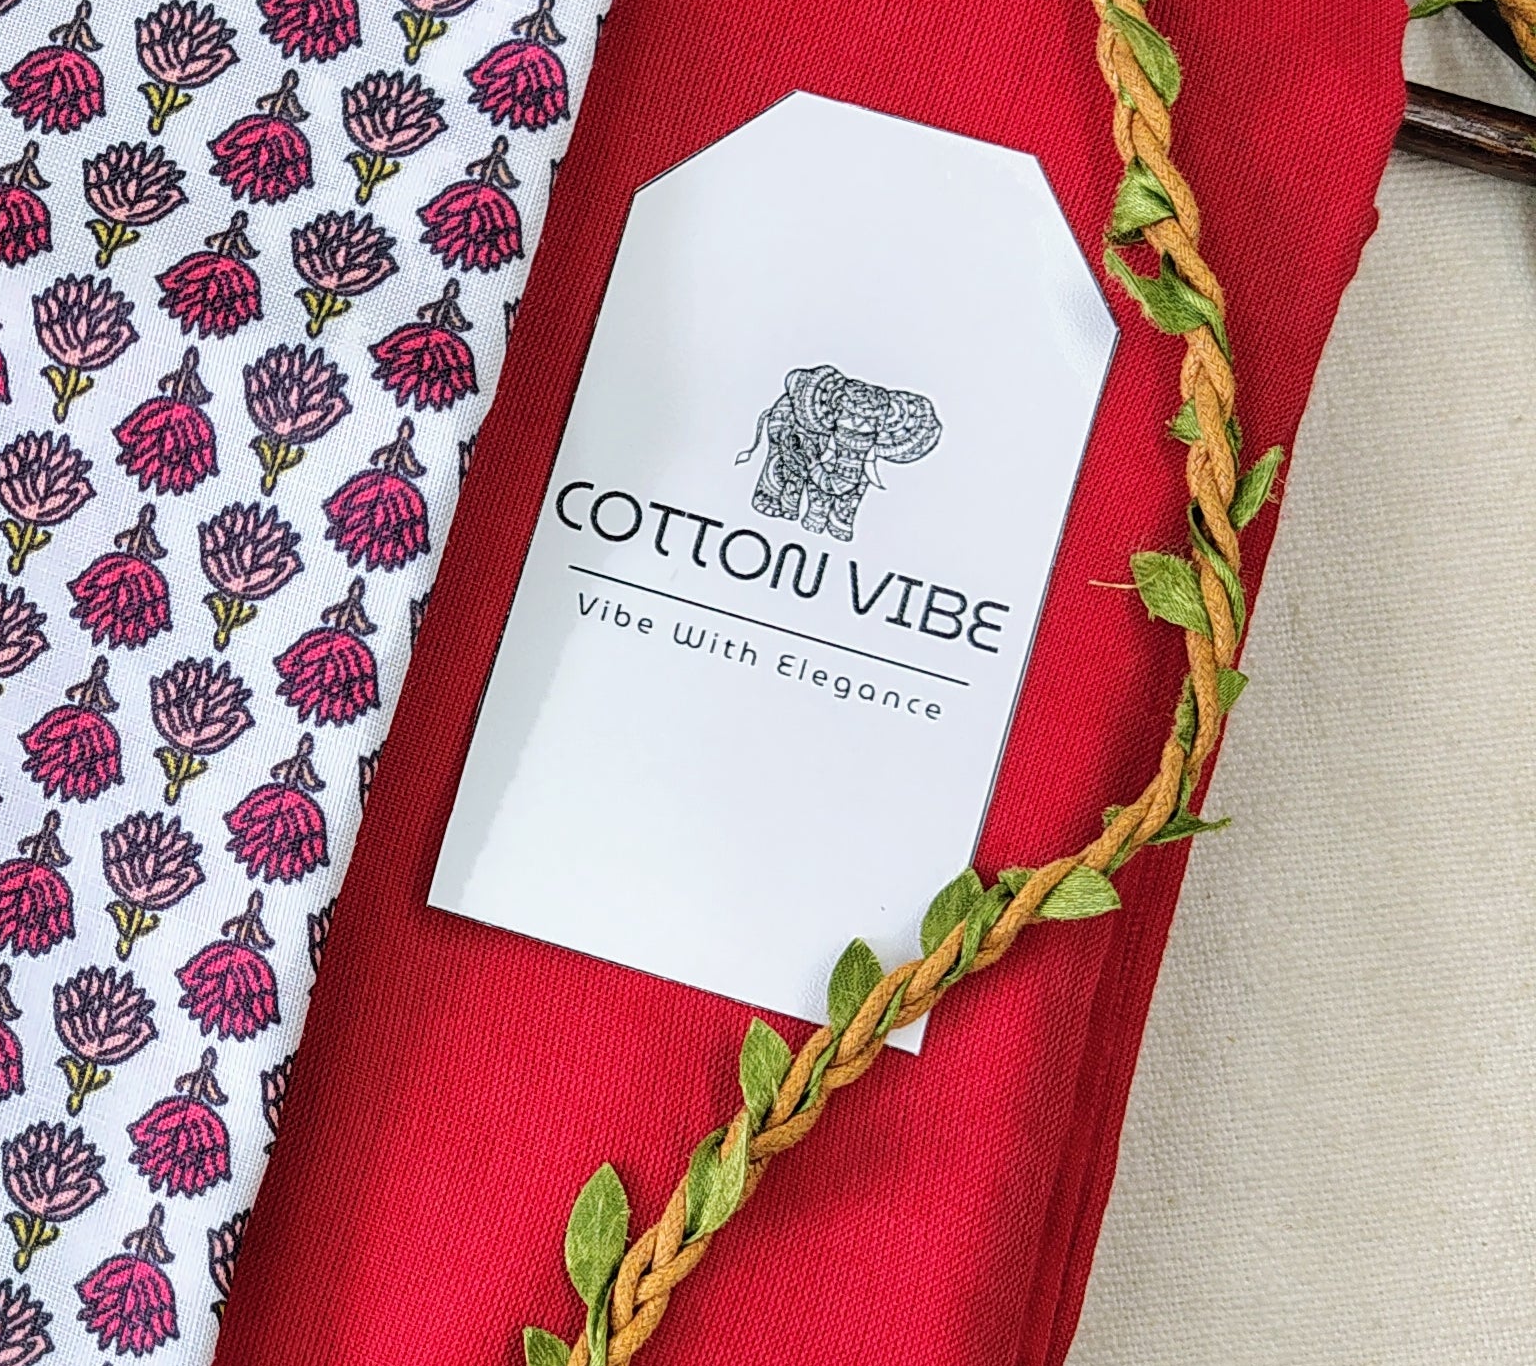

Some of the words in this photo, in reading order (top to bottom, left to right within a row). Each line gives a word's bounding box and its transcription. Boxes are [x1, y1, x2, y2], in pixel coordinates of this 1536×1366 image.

[555, 480, 829, 600] COTTON
[849, 560, 1011, 654] VIBE
[577, 592, 654, 635] Vibe
[672, 621, 760, 667] With
[776, 654, 943, 721] Elegance
